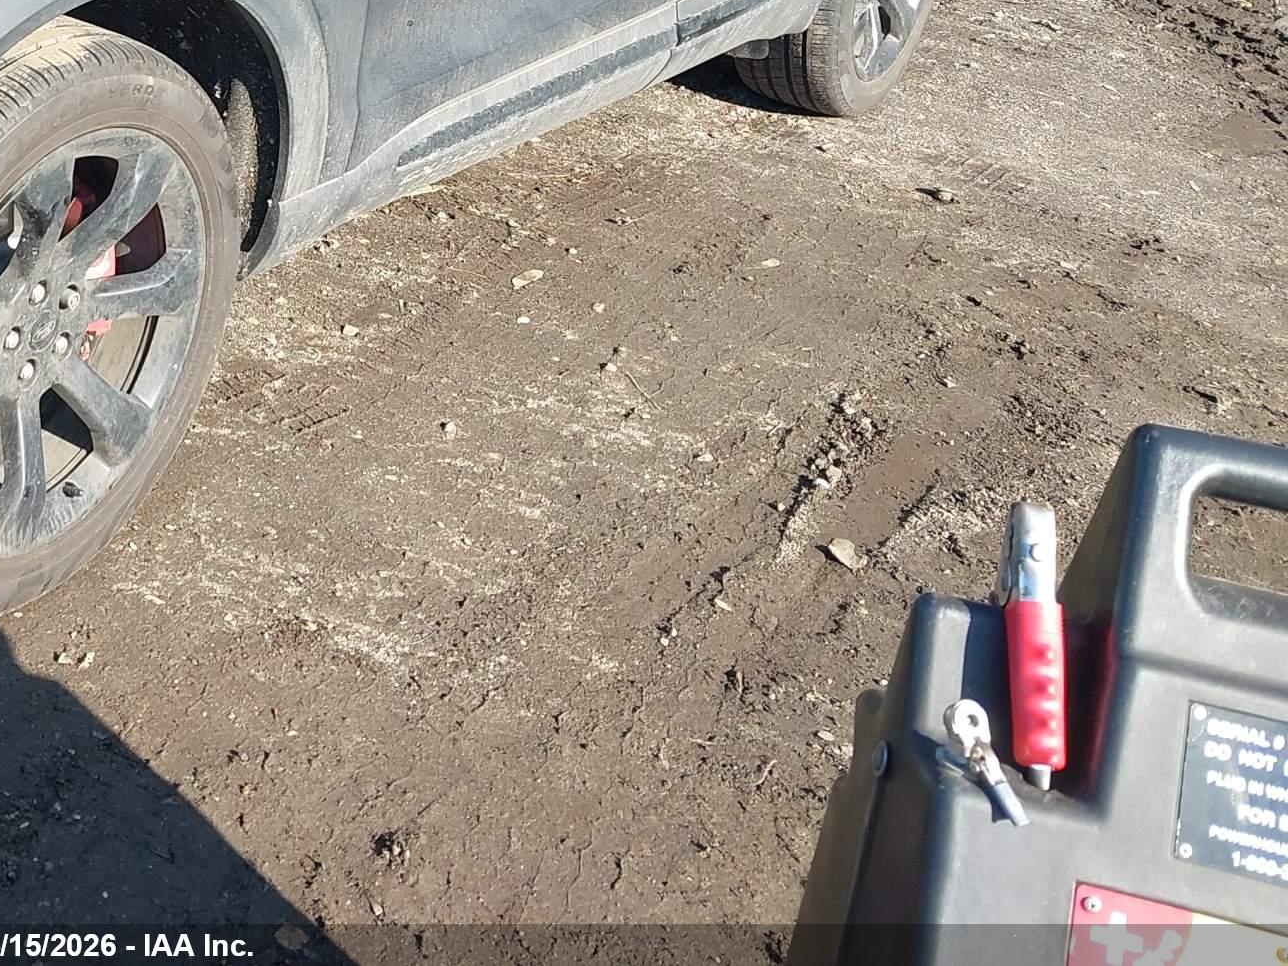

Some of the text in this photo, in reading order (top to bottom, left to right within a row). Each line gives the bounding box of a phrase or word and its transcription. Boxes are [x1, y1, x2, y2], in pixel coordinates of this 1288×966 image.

[1204, 740, 1232, 761] DO
[1238, 748, 1278, 772] NOT
[1237, 804, 1276, 828] FOR
